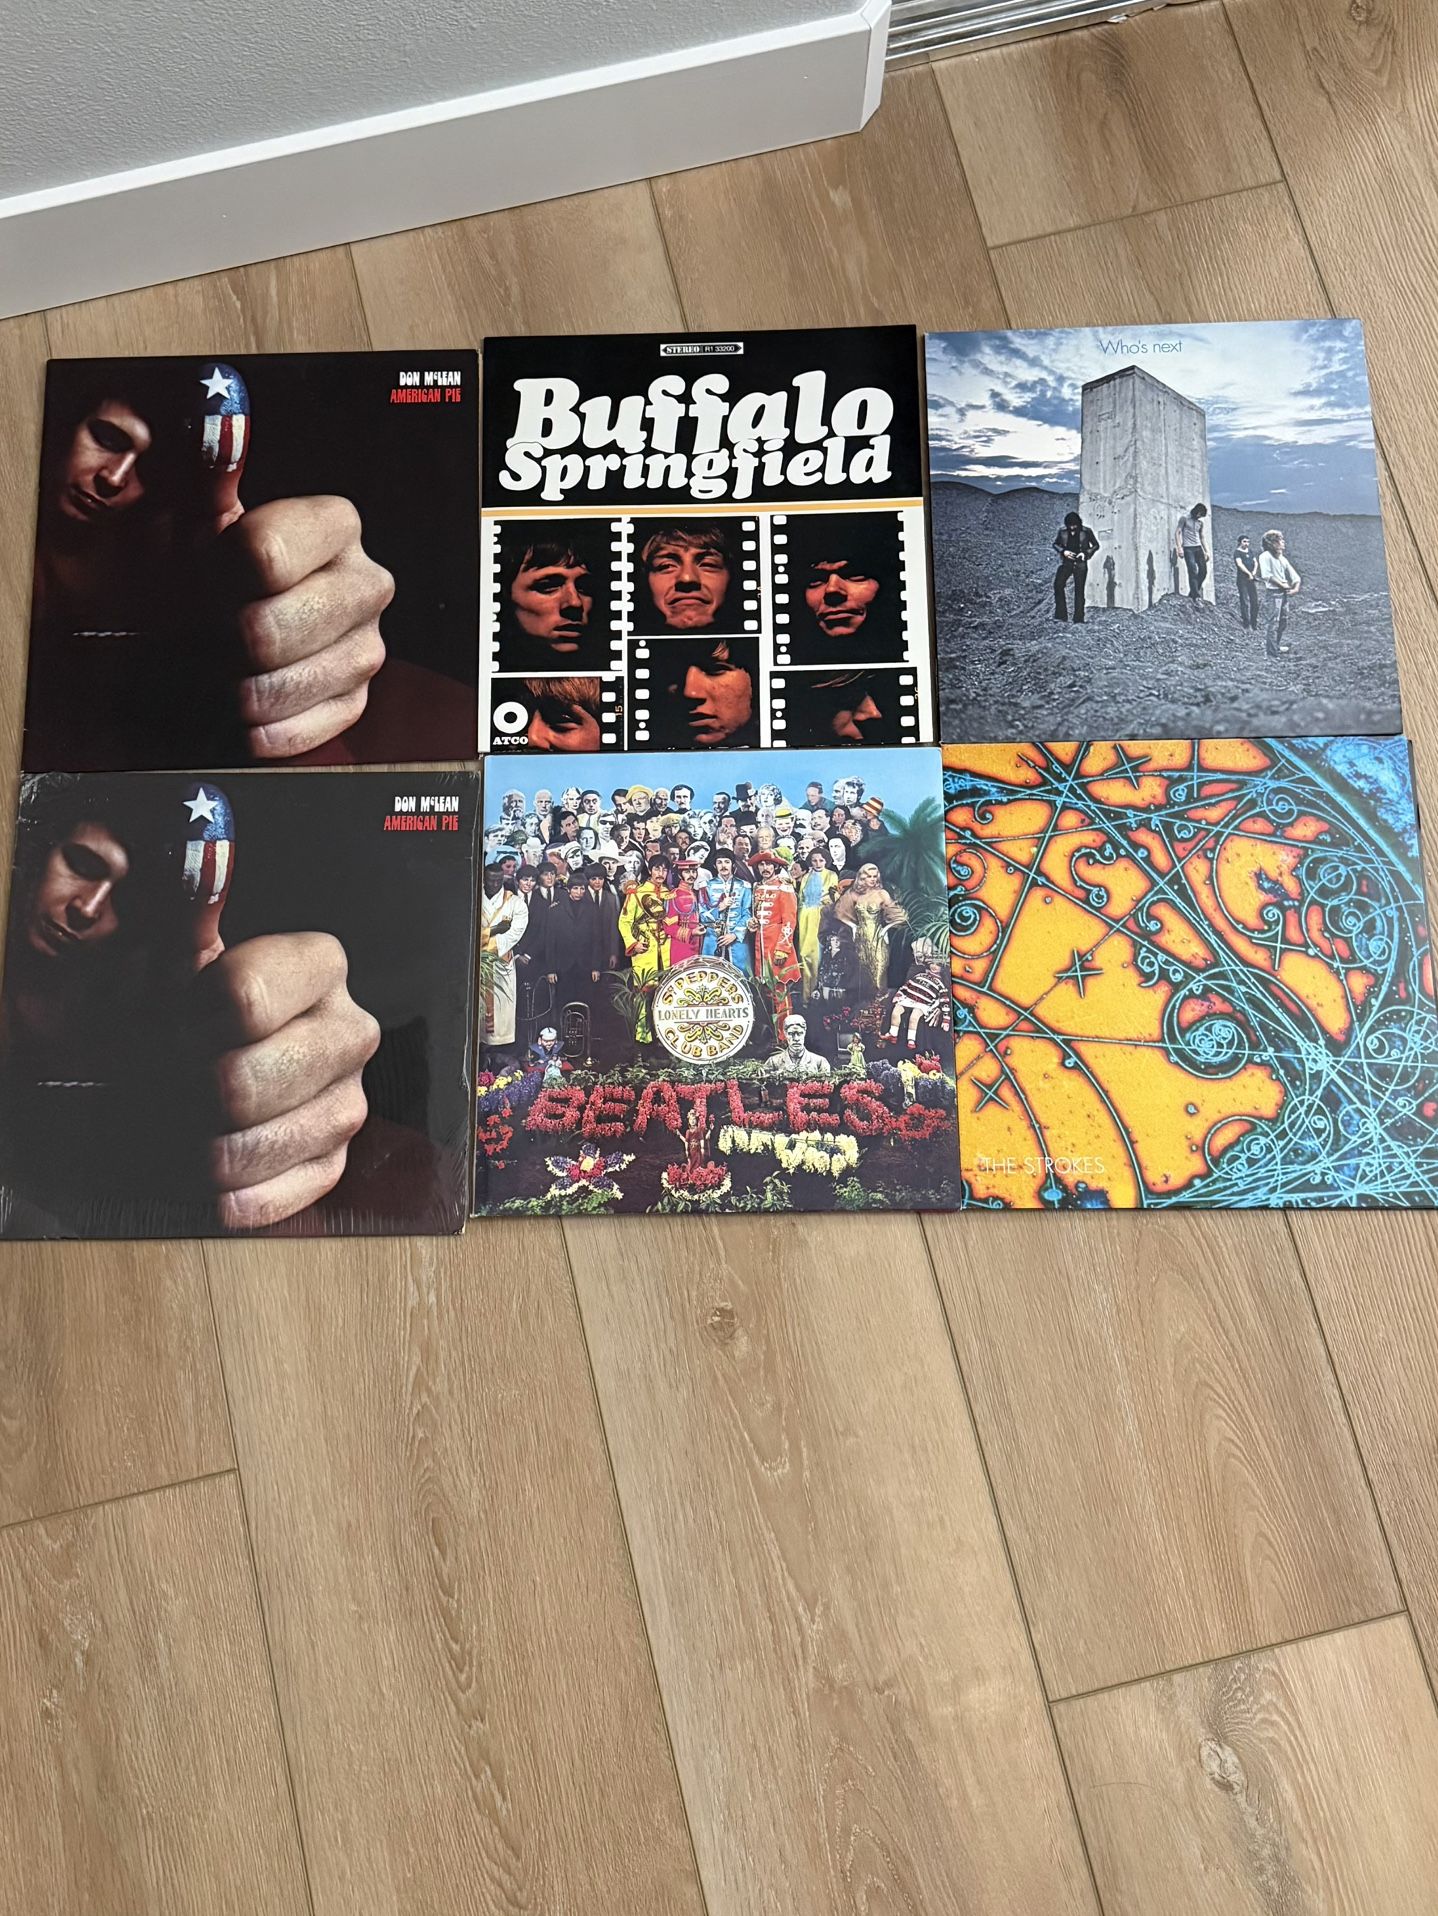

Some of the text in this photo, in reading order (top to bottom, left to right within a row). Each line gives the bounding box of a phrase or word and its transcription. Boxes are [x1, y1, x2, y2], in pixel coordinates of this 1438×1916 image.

[666, 345, 700, 354] STEREO
[1099, 338, 1183, 354] Who's next
[399, 371, 420, 386] DON
[390, 387, 461, 403] AMERICAN PIE
[506, 370, 894, 454] Buffalo
[499, 434, 892, 501] Springfield
[492, 736, 528, 745] ATCO
[394, 796, 416, 812] DON
[383, 815, 459, 831] AMERICAN PIE
[675, 970, 744, 1005] PEPPERS
[657, 1007, 749, 1021] LONELY HEARTS
[665, 1024, 744, 1058] CLUB BAND
[525, 1079, 898, 1137] BEATLES
[982, 1156, 1105, 1175] THE STROKES
